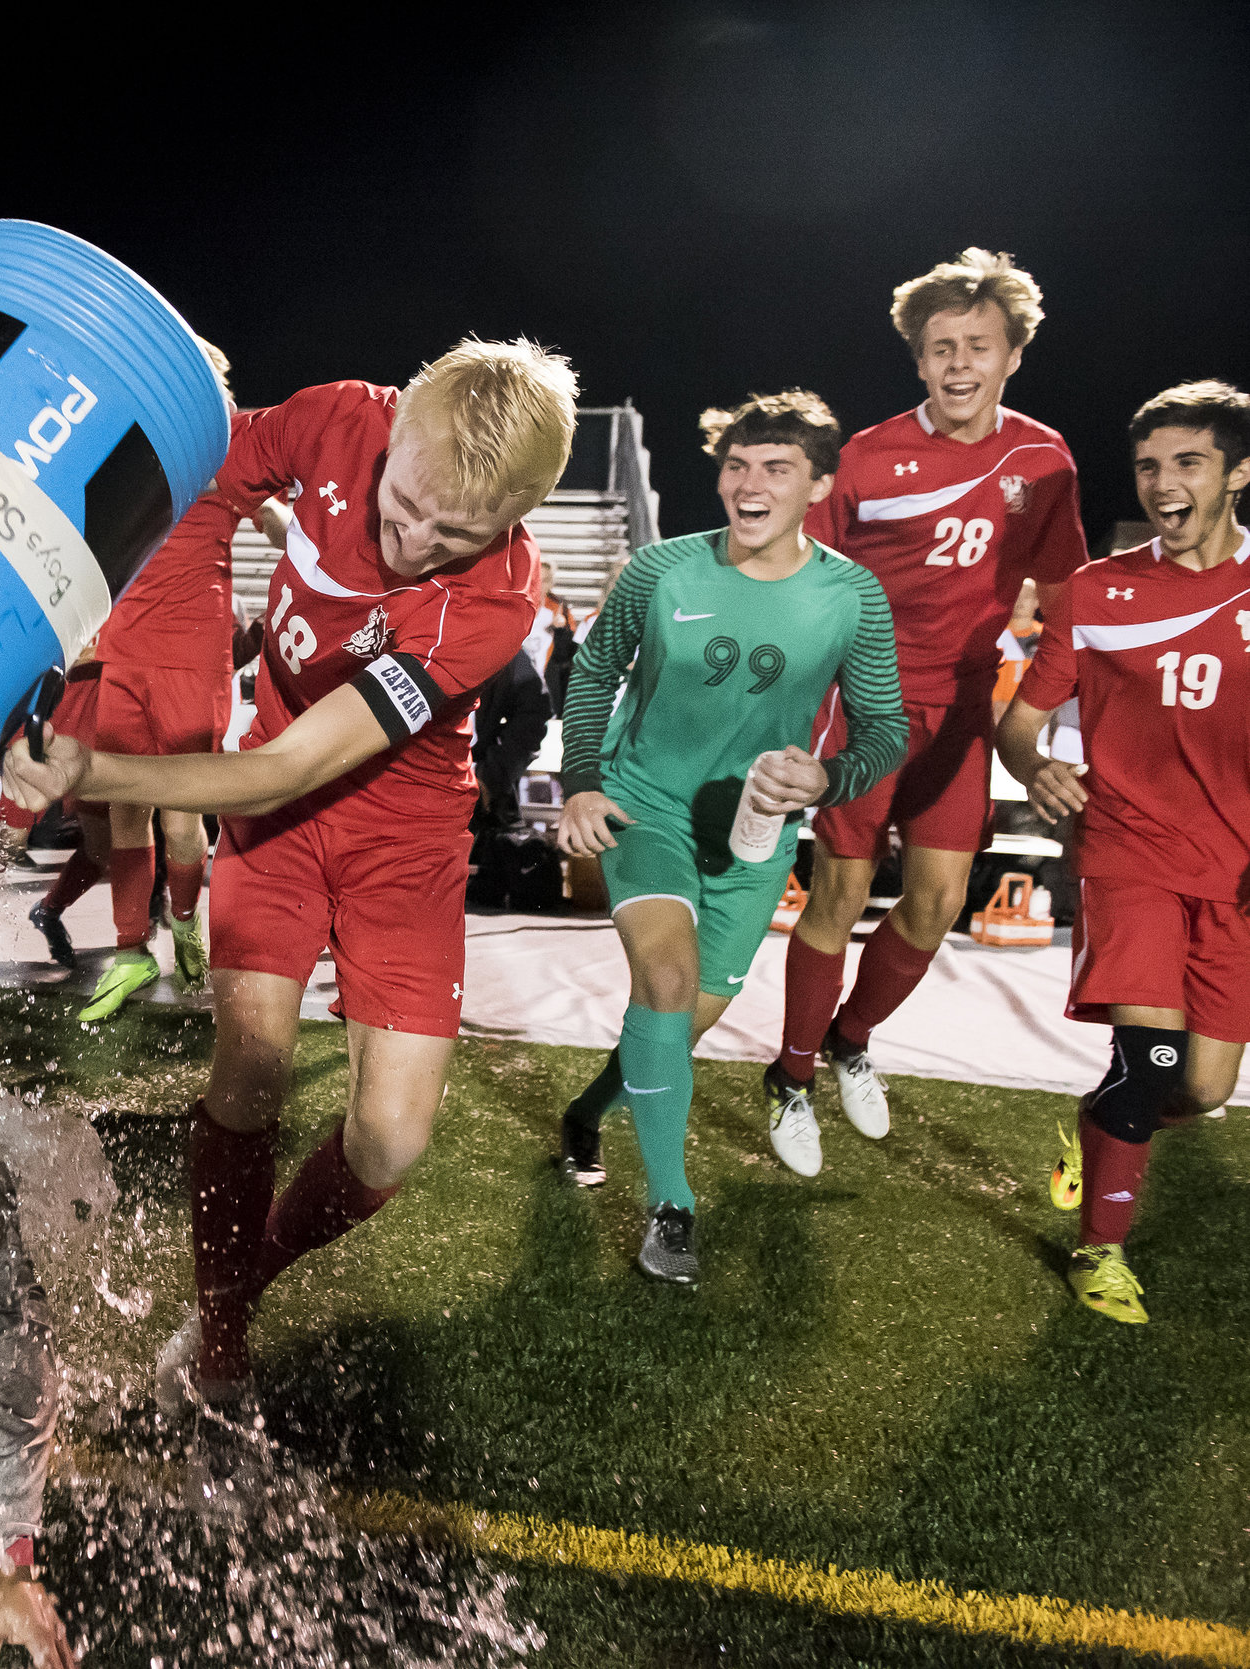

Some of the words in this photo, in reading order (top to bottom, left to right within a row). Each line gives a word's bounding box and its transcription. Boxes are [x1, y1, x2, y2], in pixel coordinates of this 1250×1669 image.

[26, 532, 72, 608] Boys
[924, 516, 994, 567] 28
[271, 583, 317, 675] 18
[703, 635, 786, 695] 99
[1156, 651, 1222, 710] 19
